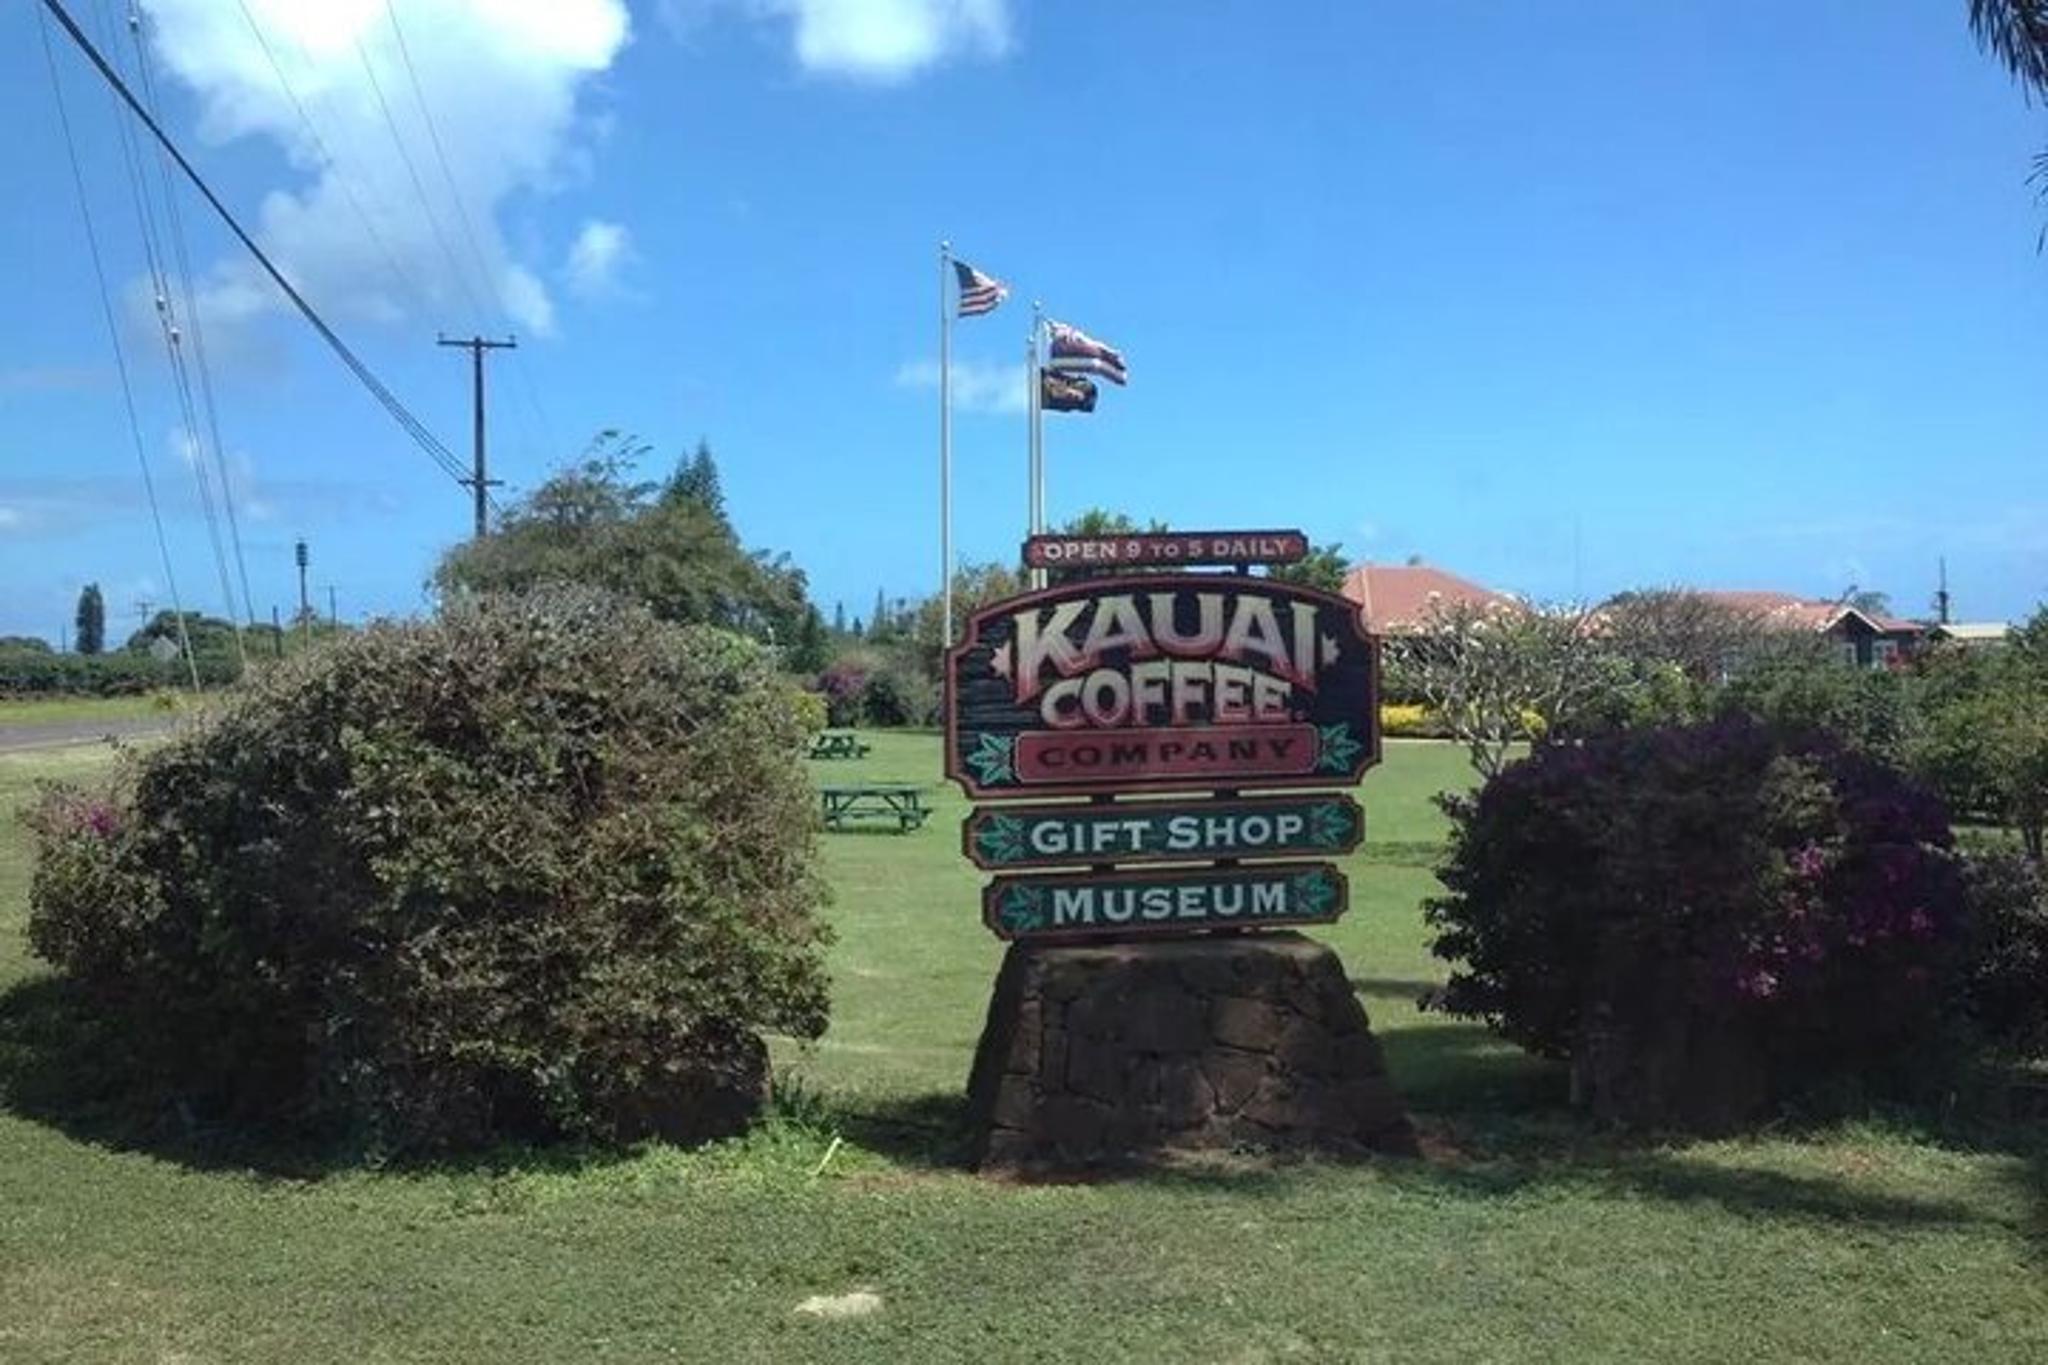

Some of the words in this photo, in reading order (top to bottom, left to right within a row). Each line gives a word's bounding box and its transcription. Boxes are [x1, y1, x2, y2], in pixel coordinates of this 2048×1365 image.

[1043, 541, 1117, 561] OPEN
[1126, 541, 1142, 559] 9
[1212, 538, 1289, 557] DAILY
[1014, 593, 1319, 706] KAUAI
[1040, 658, 1294, 729] COFFEE
[1036, 737, 1297, 768] COMPANY
[1030, 820, 1151, 854] GIFT
[1167, 814, 1304, 850] SHOP
[1052, 881, 1288, 925] MUSEUM
